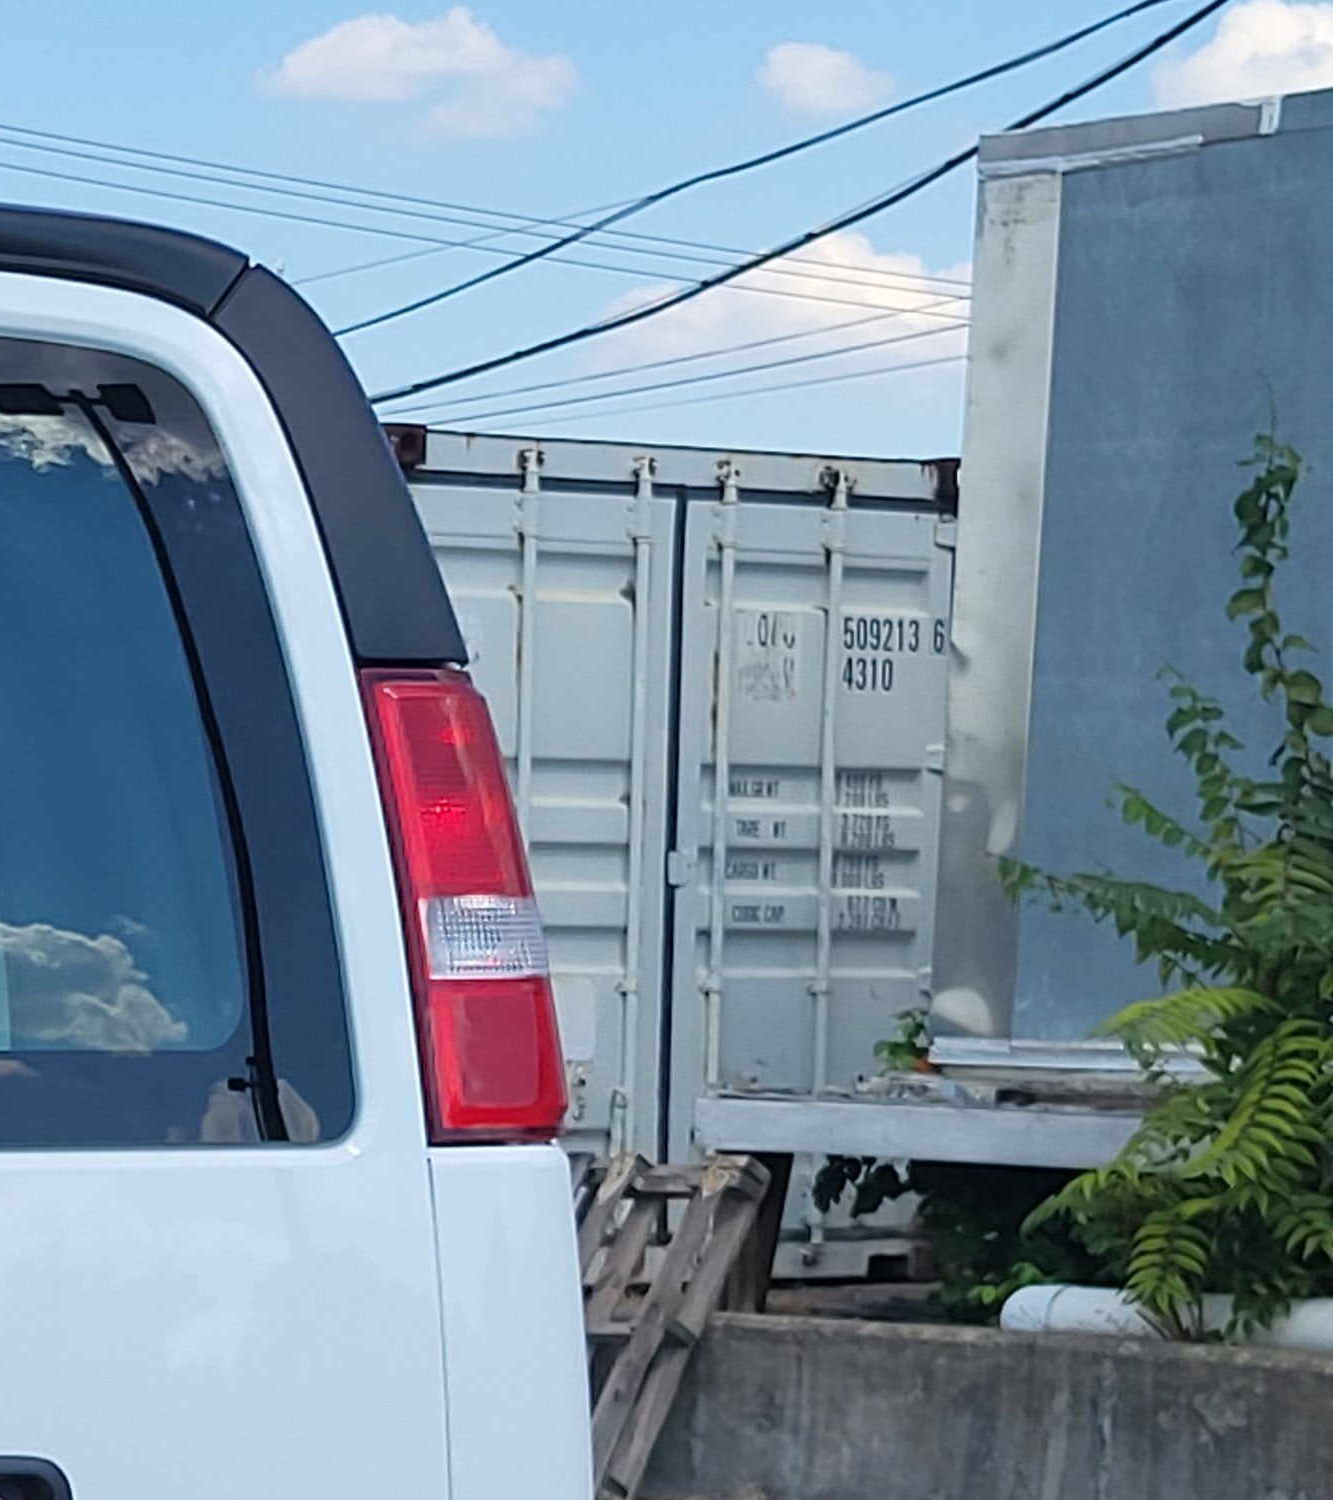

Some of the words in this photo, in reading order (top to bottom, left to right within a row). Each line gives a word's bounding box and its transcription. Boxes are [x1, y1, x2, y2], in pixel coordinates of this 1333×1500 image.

[843, 616, 920, 652] 509213
[933, 618, 946, 653] 6
[842, 656, 894, 692] 4310
